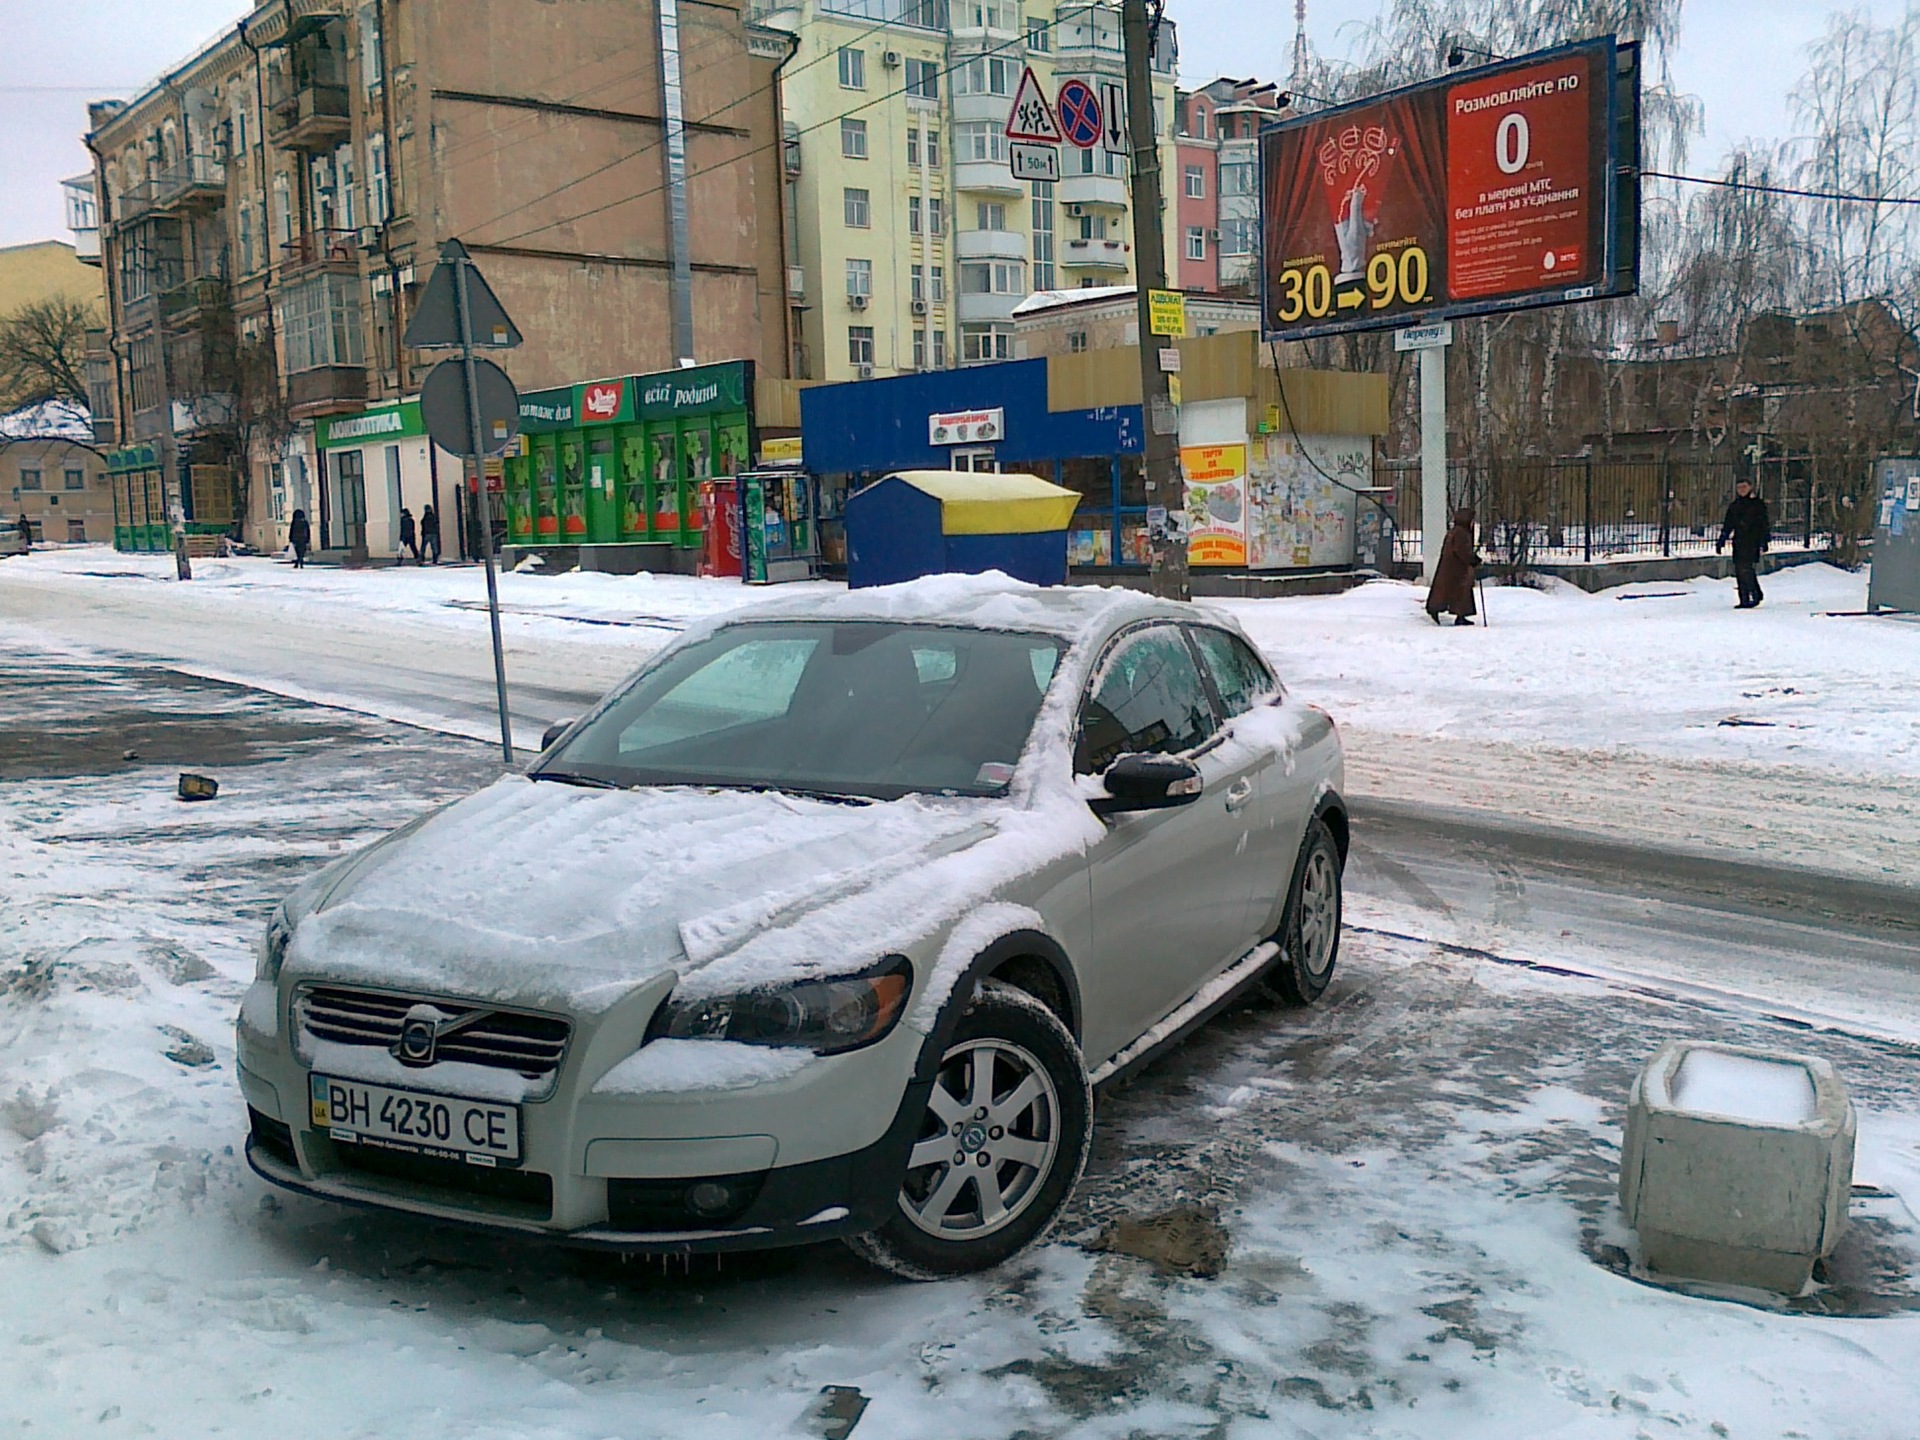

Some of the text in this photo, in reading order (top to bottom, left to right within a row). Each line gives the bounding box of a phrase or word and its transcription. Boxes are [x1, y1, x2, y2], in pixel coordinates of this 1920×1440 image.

[1455, 75, 1579, 116] Розмовляйте по
[1495, 112, 1530, 174] 0
[1455, 187, 1579, 220] без плати за з'єднання
[1479, 178, 1552, 203] в мережі МТС
[1278, 264, 1332, 322] 30
[1367, 247, 1429, 310] 90
[673, 382, 718, 409] родини
[380, 1095, 450, 1141] 4230
